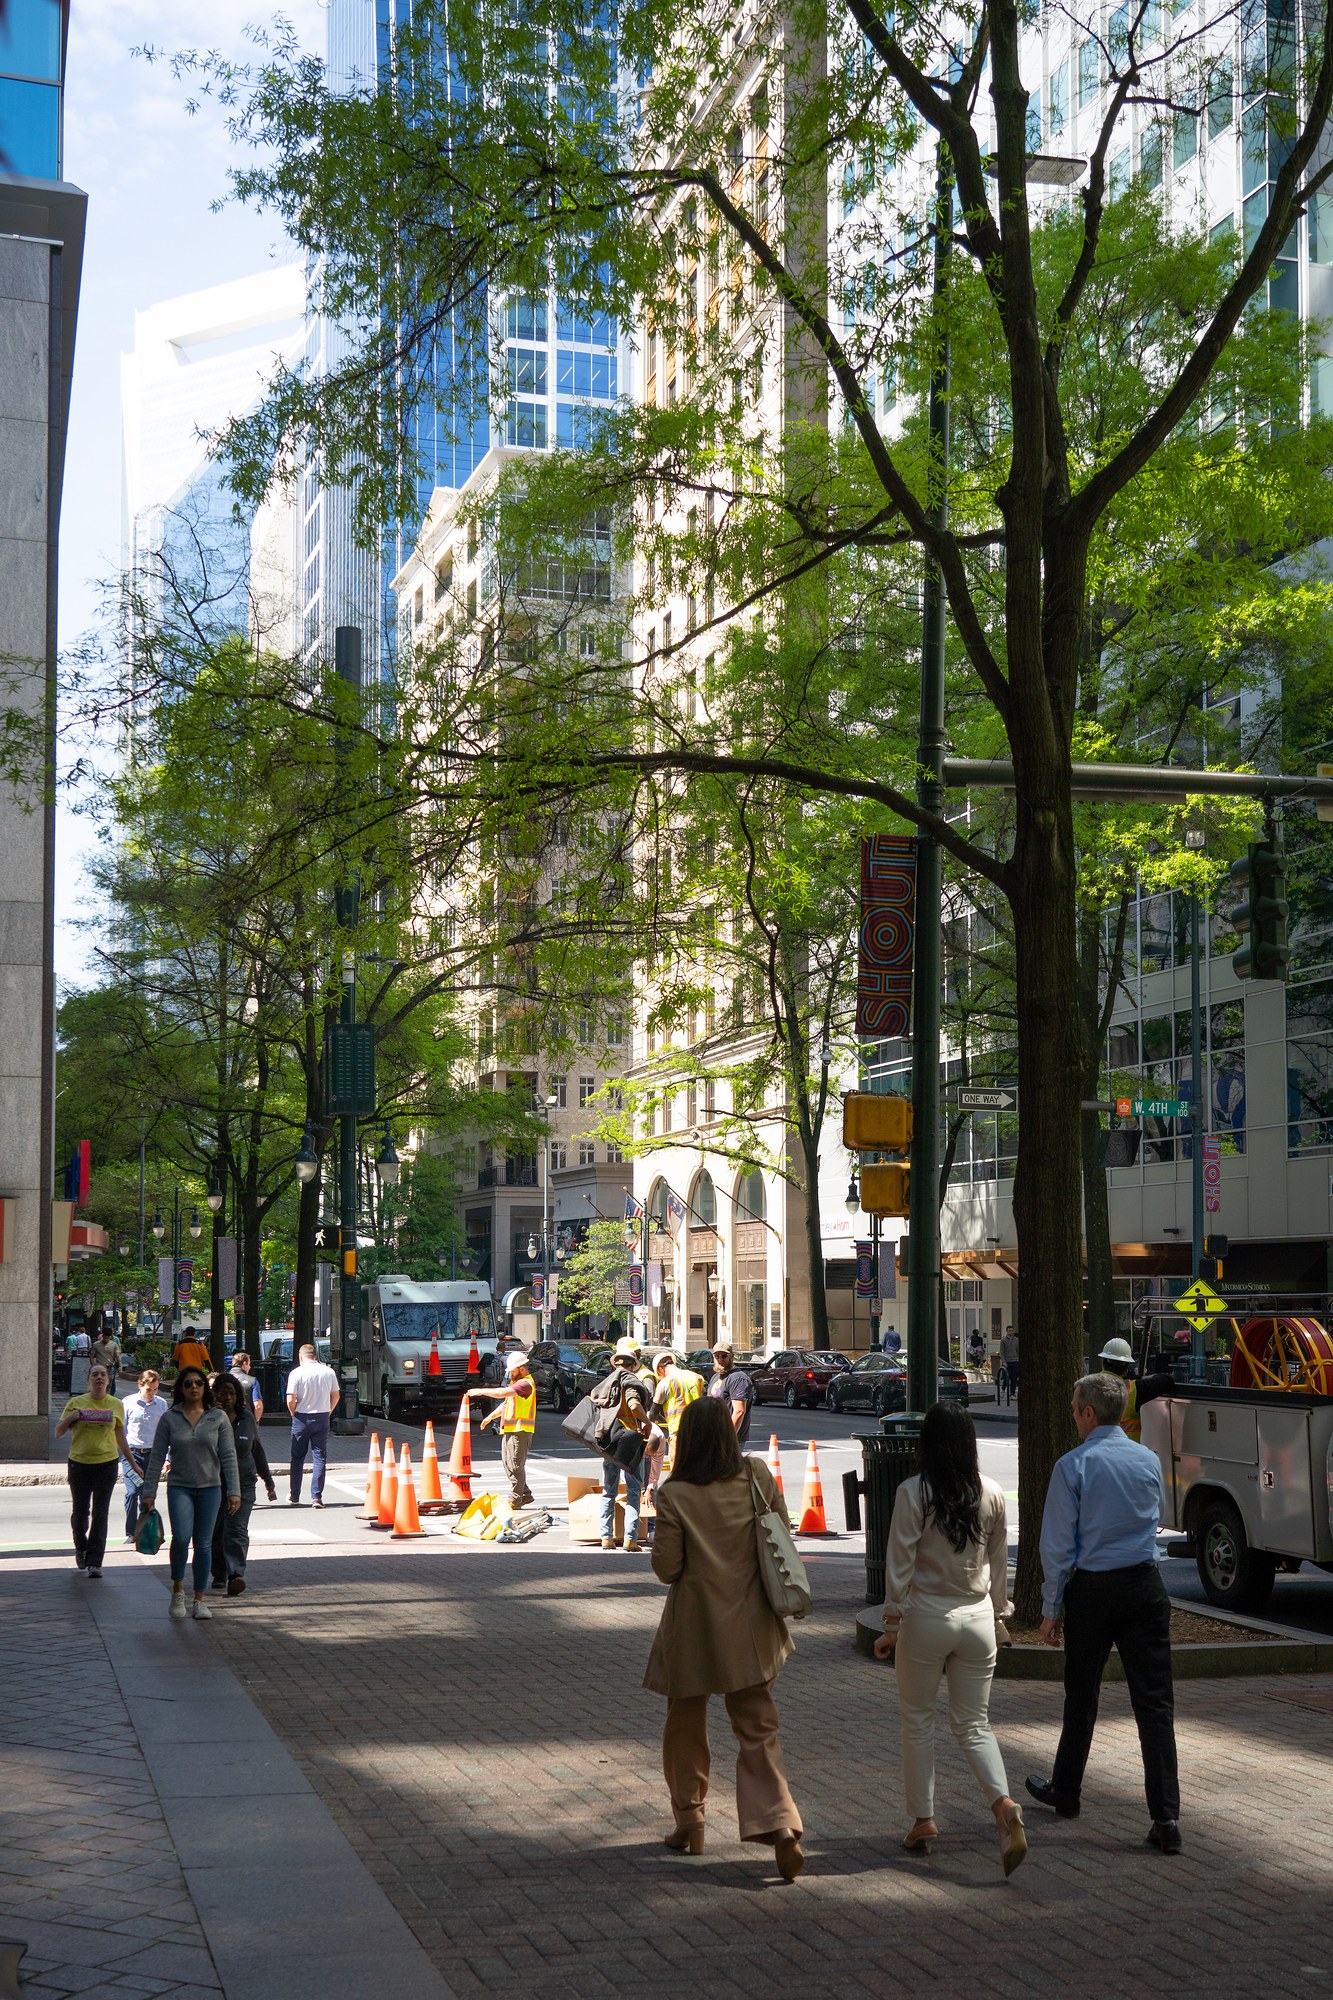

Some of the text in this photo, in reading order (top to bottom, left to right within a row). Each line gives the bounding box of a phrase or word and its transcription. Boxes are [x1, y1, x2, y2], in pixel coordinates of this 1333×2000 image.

[855, 833, 917, 1037] SHOUT
[964, 1094, 999, 1104] ONE WAY
[1135, 1101, 1168, 1114] W. 4TH
[1180, 1101, 1188, 1109] ST
[1177, 1109, 1188, 1117] 100
[1202, 1135, 1221, 1212] SHOUT
